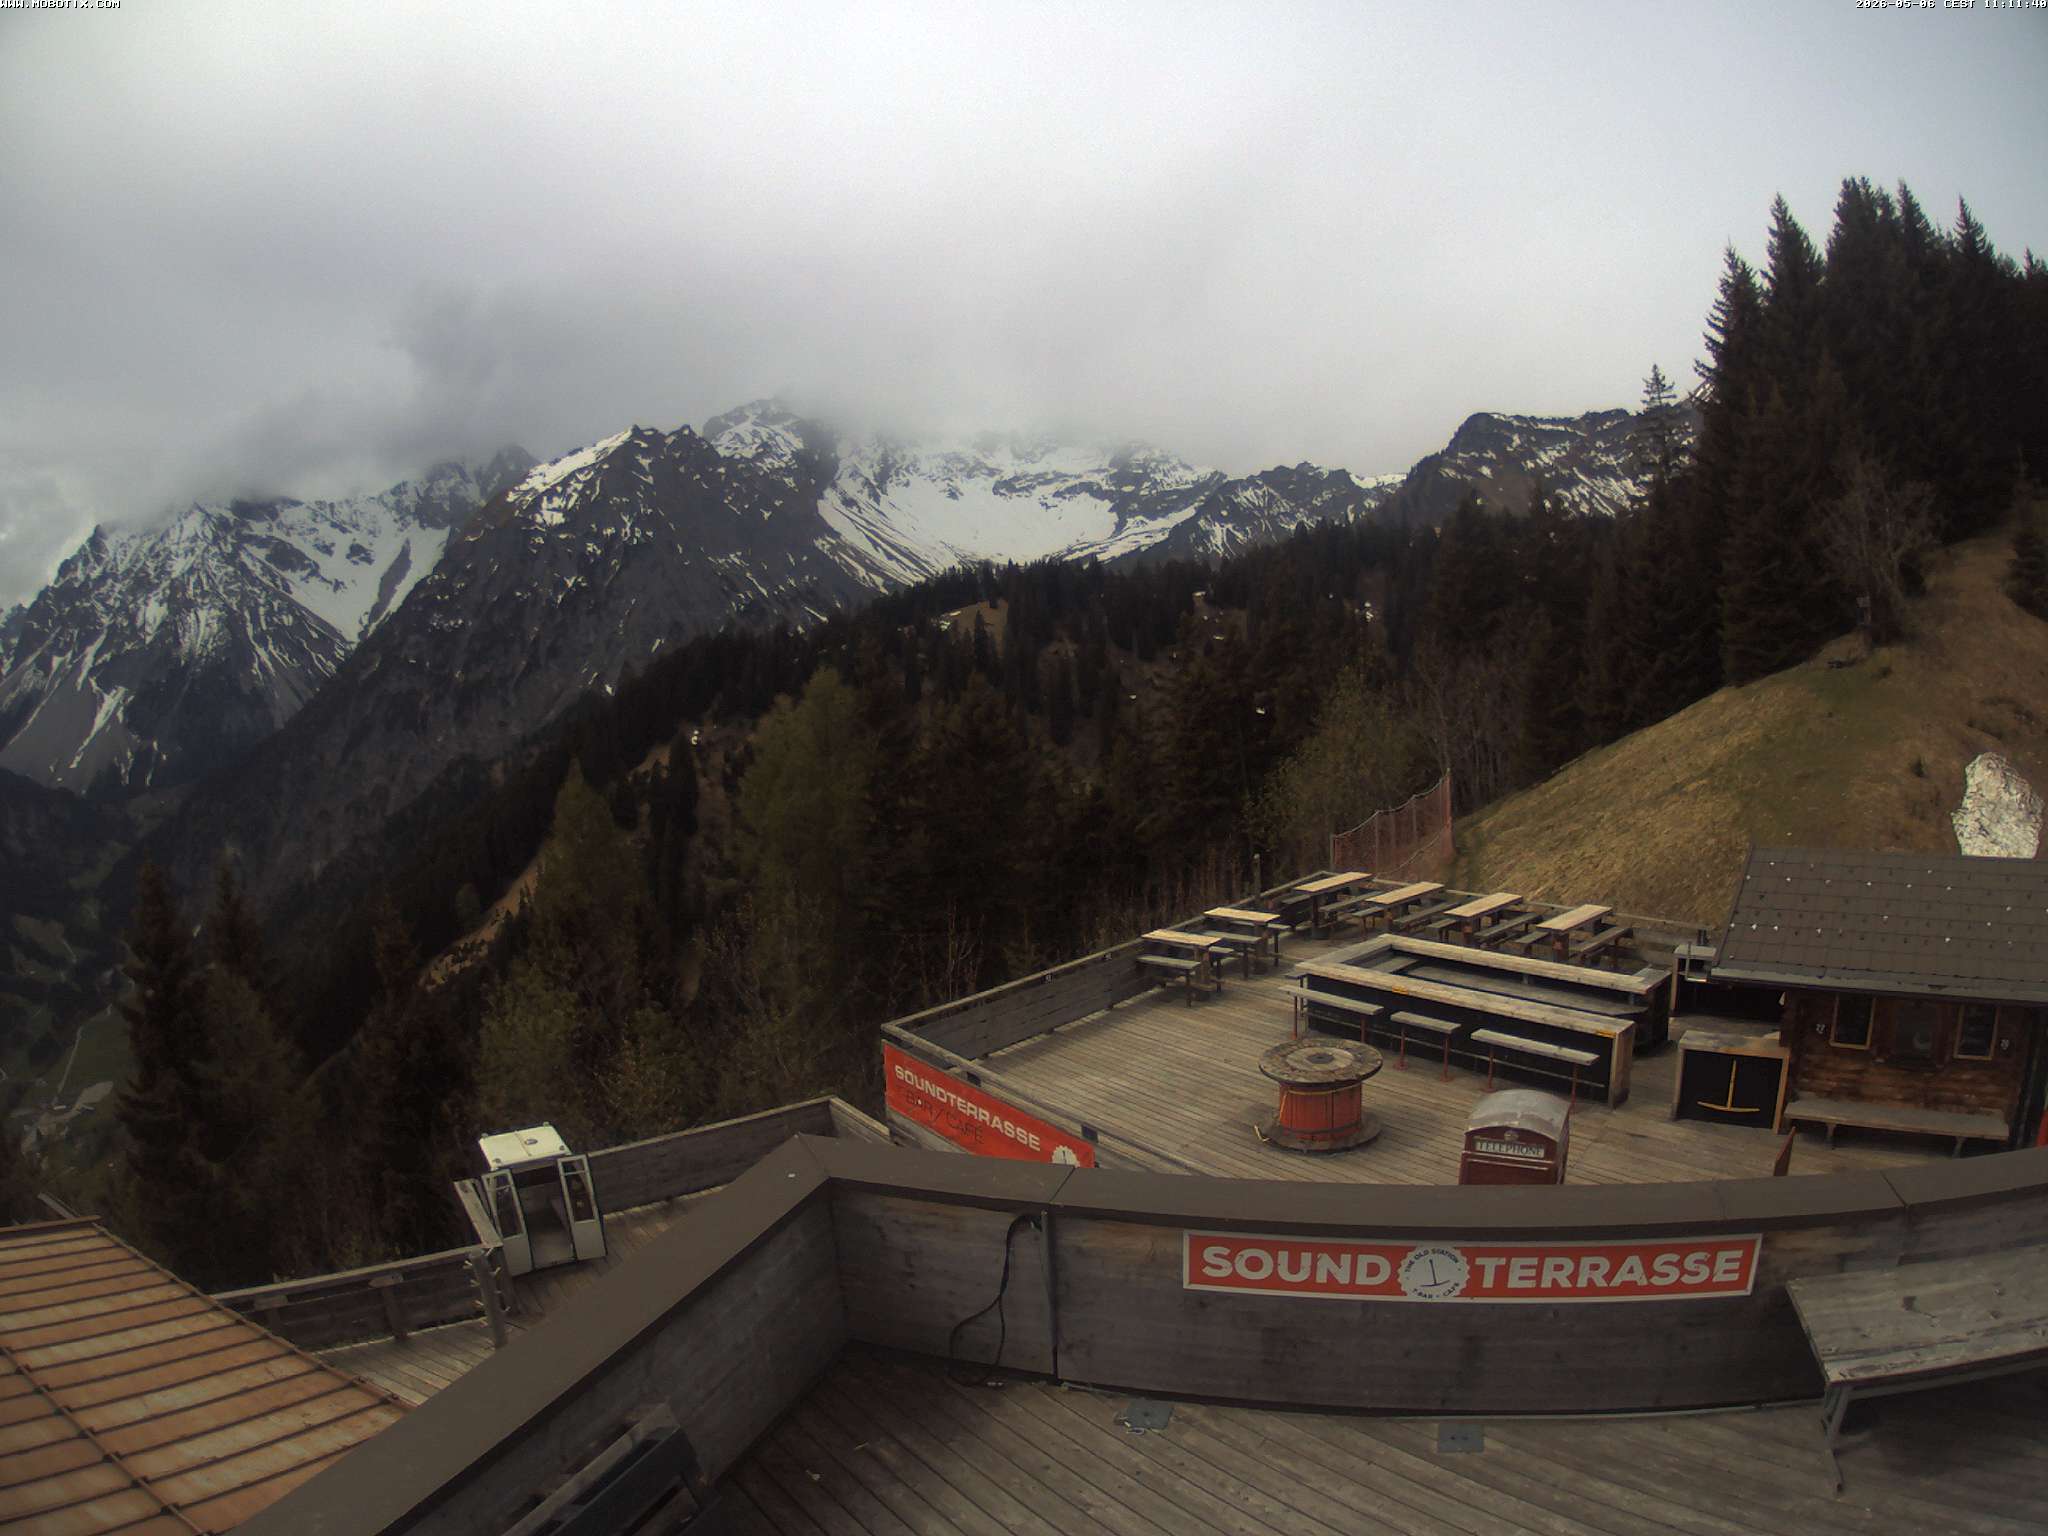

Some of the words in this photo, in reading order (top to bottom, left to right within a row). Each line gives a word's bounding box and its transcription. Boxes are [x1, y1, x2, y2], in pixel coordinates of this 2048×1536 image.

[894, 1064, 1041, 1151] SOUNDTERRASSE
[1479, 1141, 1542, 1156] TELEPHONE
[1202, 1247, 1390, 1285] SOUND
[1475, 1250, 1744, 1288] TERRASSE
